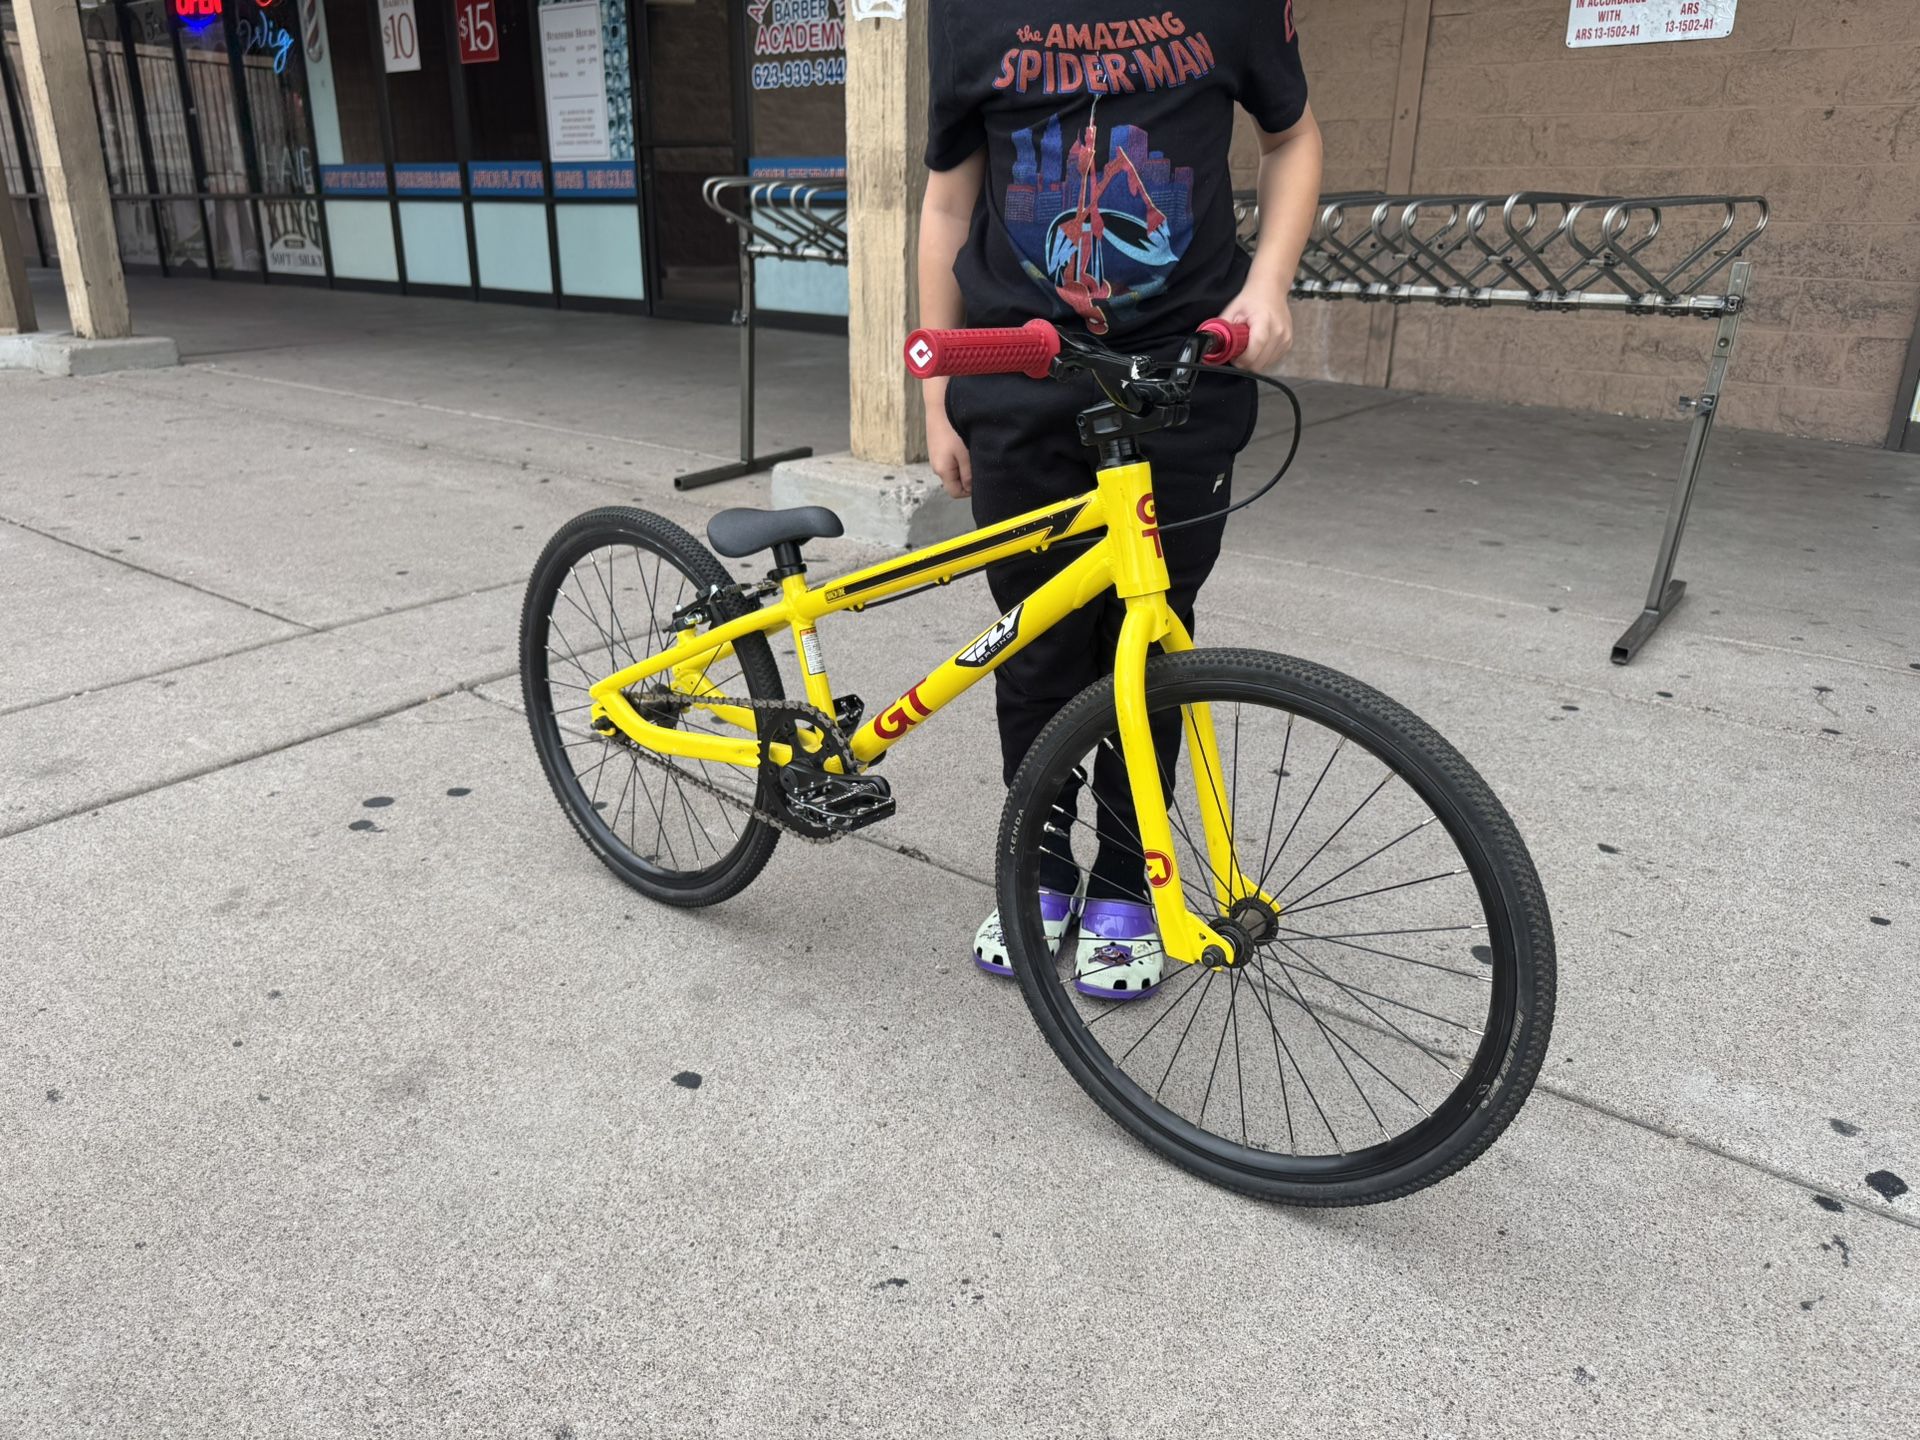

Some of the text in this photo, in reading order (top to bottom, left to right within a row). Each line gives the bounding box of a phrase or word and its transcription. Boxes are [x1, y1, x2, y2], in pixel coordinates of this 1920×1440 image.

[460, 2, 494, 51] $15
[773, 0, 828, 22] BARBER
[1598, 10, 1622, 22] WITH
[1665, 18, 1714, 33] 13-1502-A1
[1680, 3, 1700, 15] ARS
[237, 9, 294, 74] Wig
[383, 13, 415, 59] $10
[755, 19, 845, 54] ACADEMY
[1016, 11, 1186, 50] the AMAZING
[1575, 25, 1640, 41] ARS 13-1502-A1
[753, 57, 845, 89] 623-939-344
[958, 604, 1023, 662] FLY
[978, 631, 1014, 664] RACING
[874, 677, 933, 739] GT
[1010, 809, 1024, 855] KENDA
